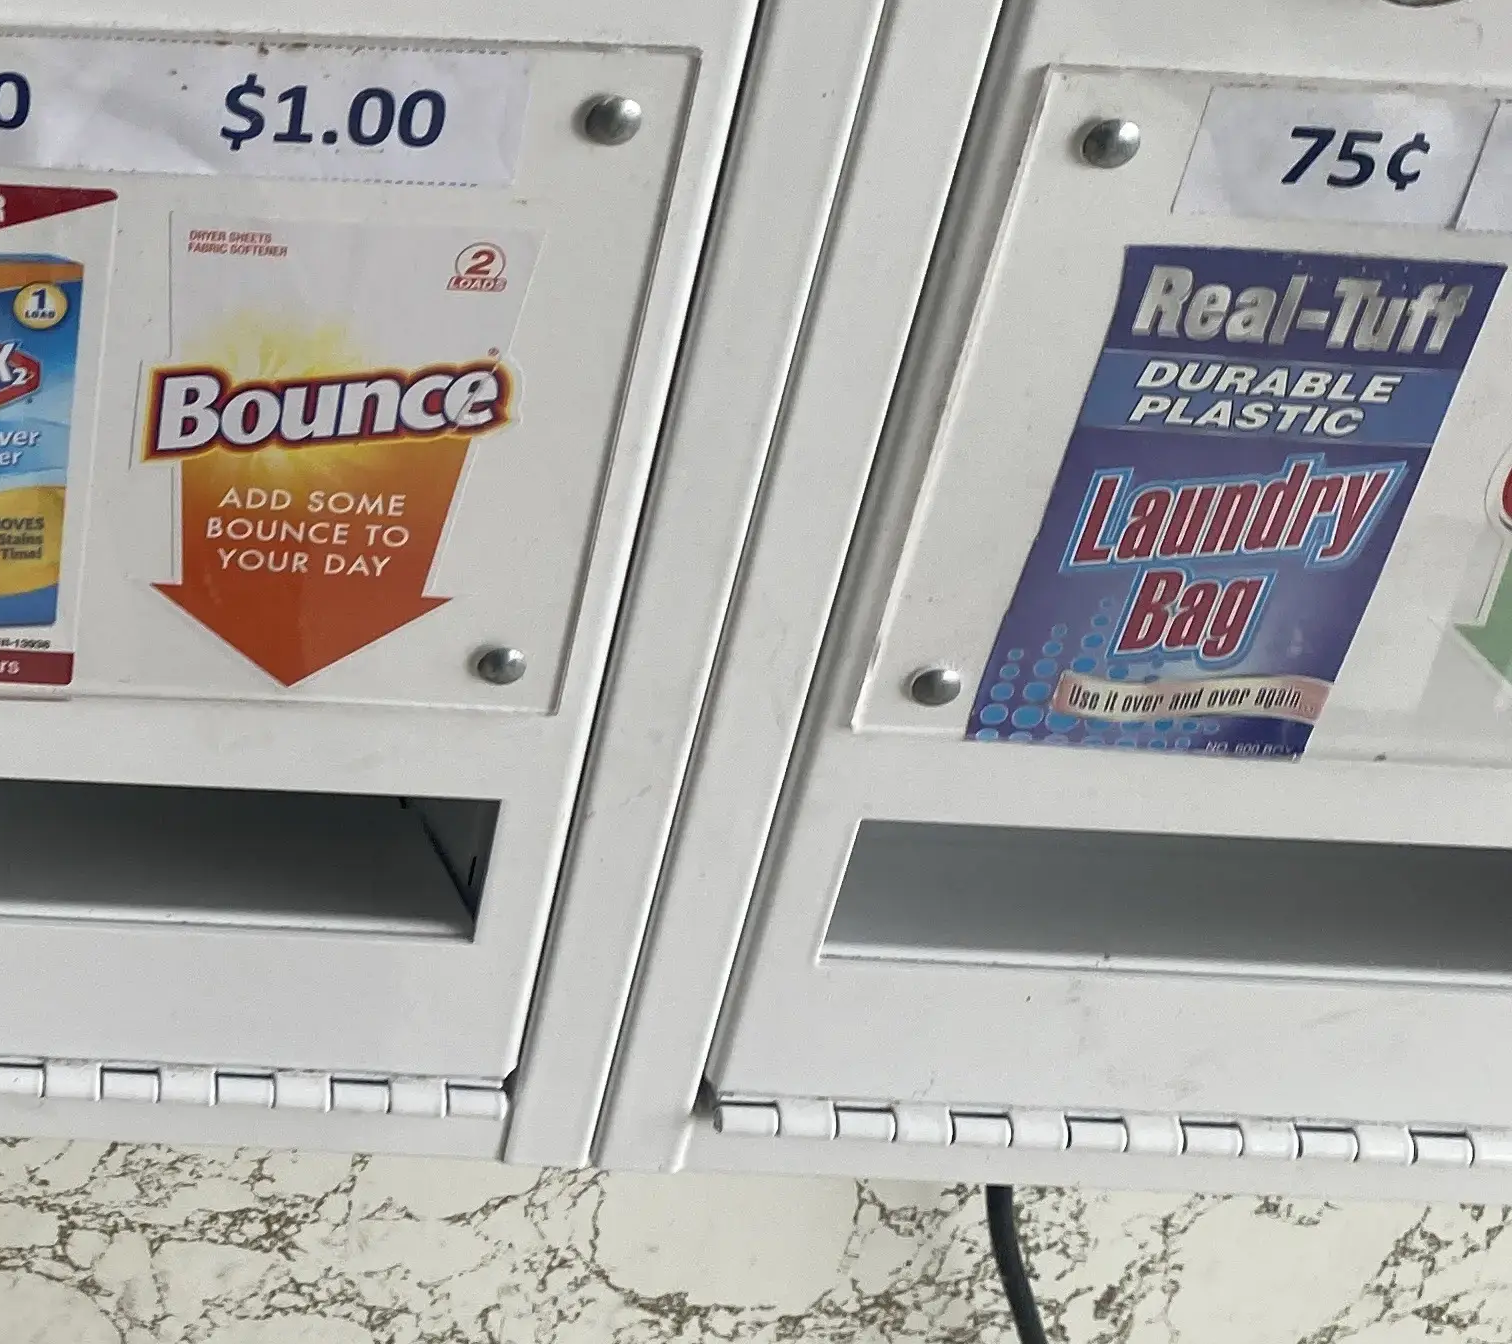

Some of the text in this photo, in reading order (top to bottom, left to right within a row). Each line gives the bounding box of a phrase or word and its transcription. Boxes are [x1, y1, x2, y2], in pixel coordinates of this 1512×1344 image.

[219, 72, 447, 151] $1.00
[1281, 125, 1431, 192] 75¢
[464, 249, 496, 276] 2
[24, 309, 56, 319] LOAD
[32, 288, 46, 310] 1
[1131, 264, 1475, 355] Real-Tuff
[1135, 359, 1402, 402] DURABLE
[154, 367, 502, 454] Bounce
[1128, 398, 1365, 436] PLASTIC
[218, 486, 406, 517] ADD SOME
[1068, 458, 1400, 570] Laundry
[205, 516, 409, 548] BOUNCE TO
[217, 548, 392, 577] YOUR DAY
[1112, 569, 1264, 662] Bag
[1068, 683, 1101, 710] Use
[1104, 690, 1119, 713] it
[1121, 695, 1164, 713] over
[1169, 687, 1205, 712] and
[1207, 686, 1251, 707] over
